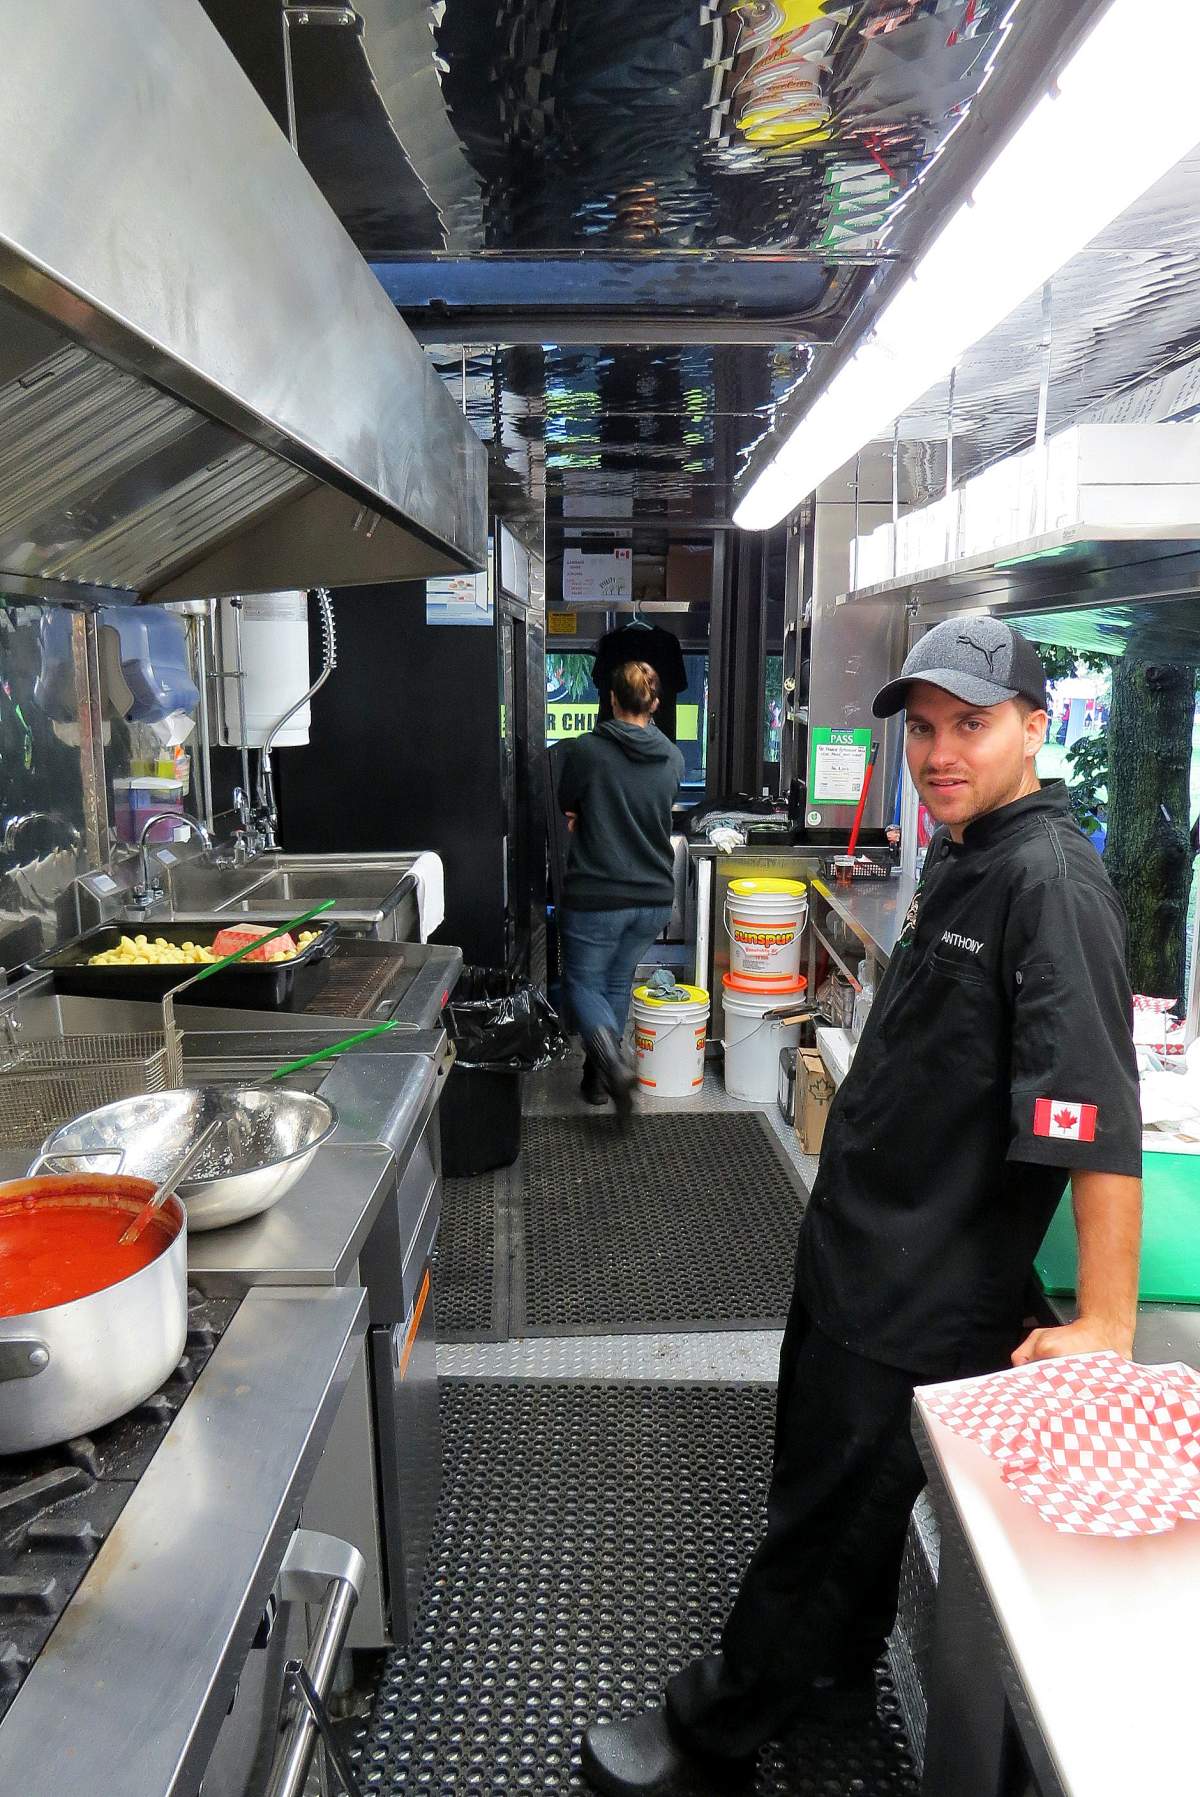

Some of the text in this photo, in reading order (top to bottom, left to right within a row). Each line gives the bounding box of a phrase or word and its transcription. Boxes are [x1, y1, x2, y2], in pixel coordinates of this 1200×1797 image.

[562, 713, 598, 731] CHI
[830, 735, 854, 744] PASS
[941, 931, 984, 953] ANTHONY
